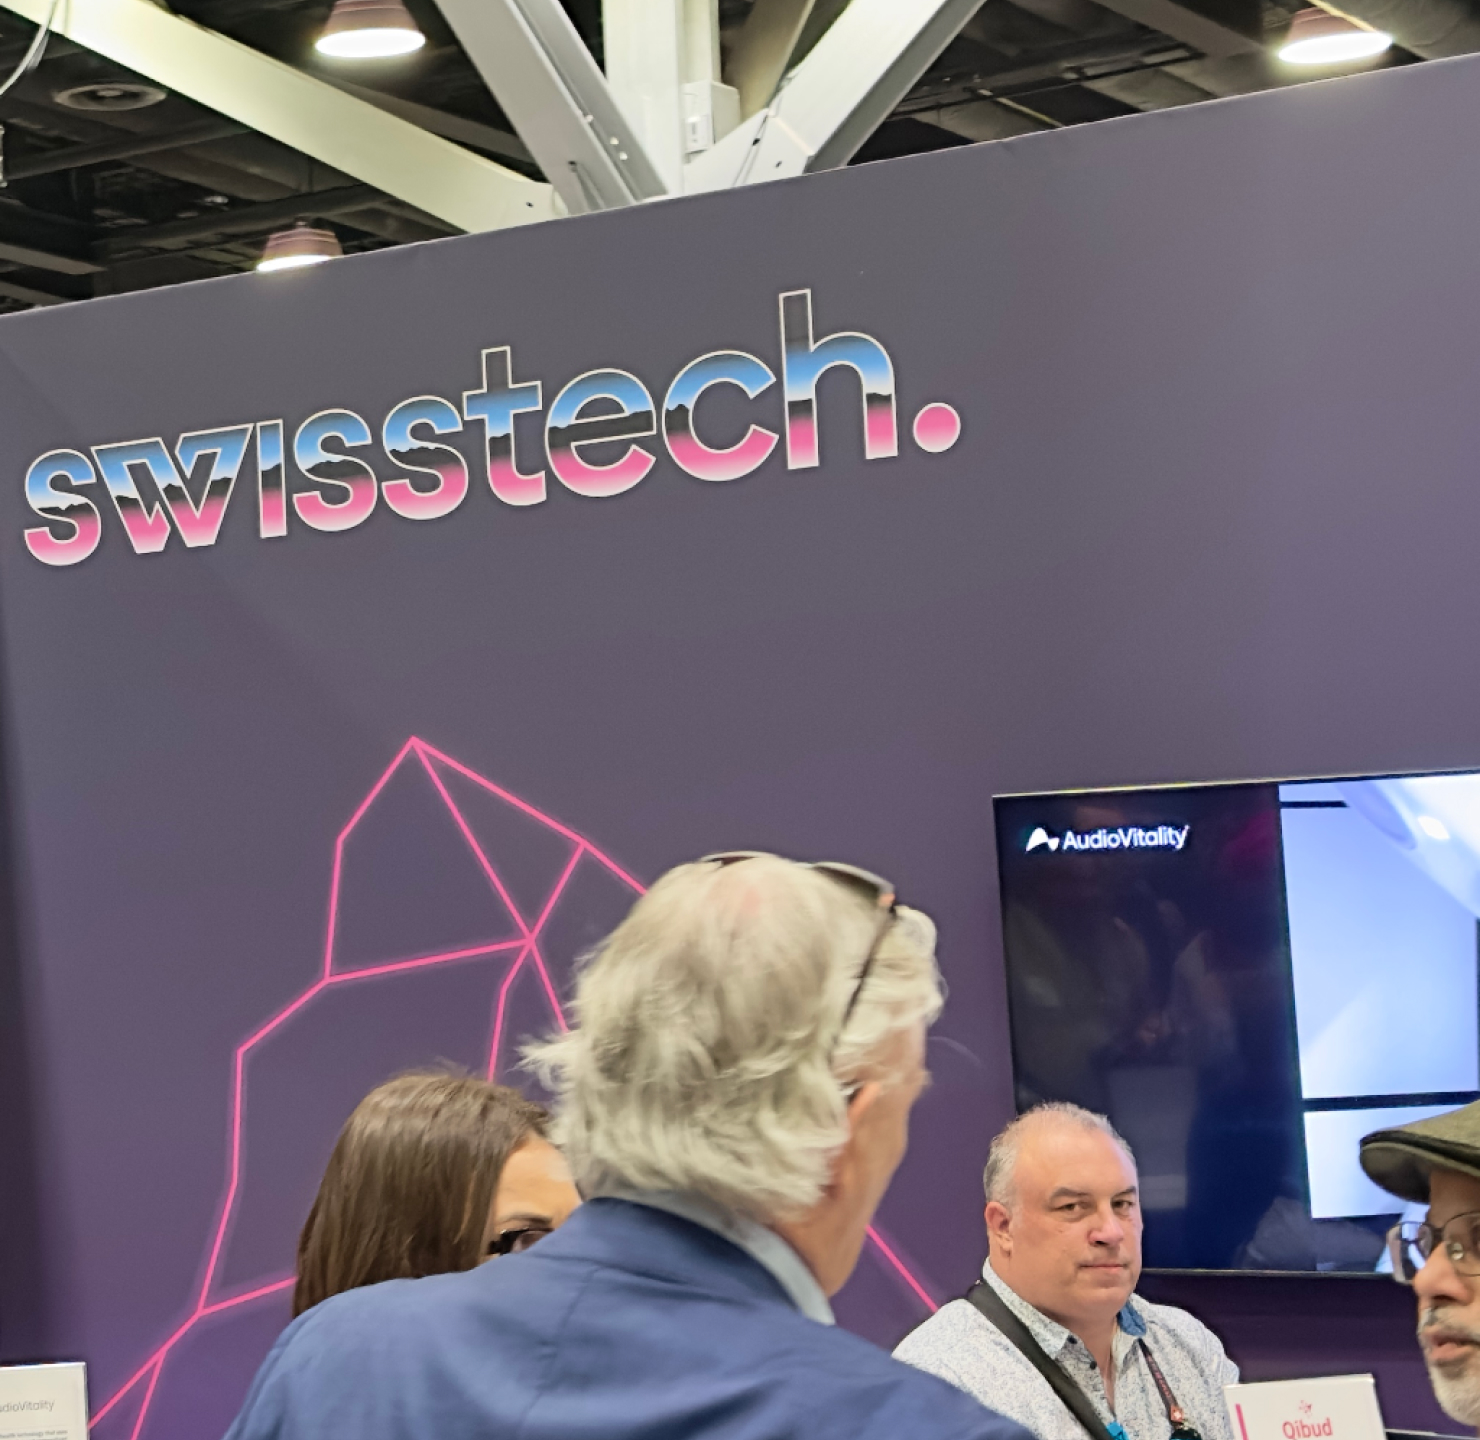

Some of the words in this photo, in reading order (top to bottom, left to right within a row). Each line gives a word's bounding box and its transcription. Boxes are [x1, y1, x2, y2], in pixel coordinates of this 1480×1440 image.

[23, 289, 961, 565] swisstech.
[1063, 825, 1190, 850] AudioVitality
[1282, 1417, 1333, 1440] Qibud
